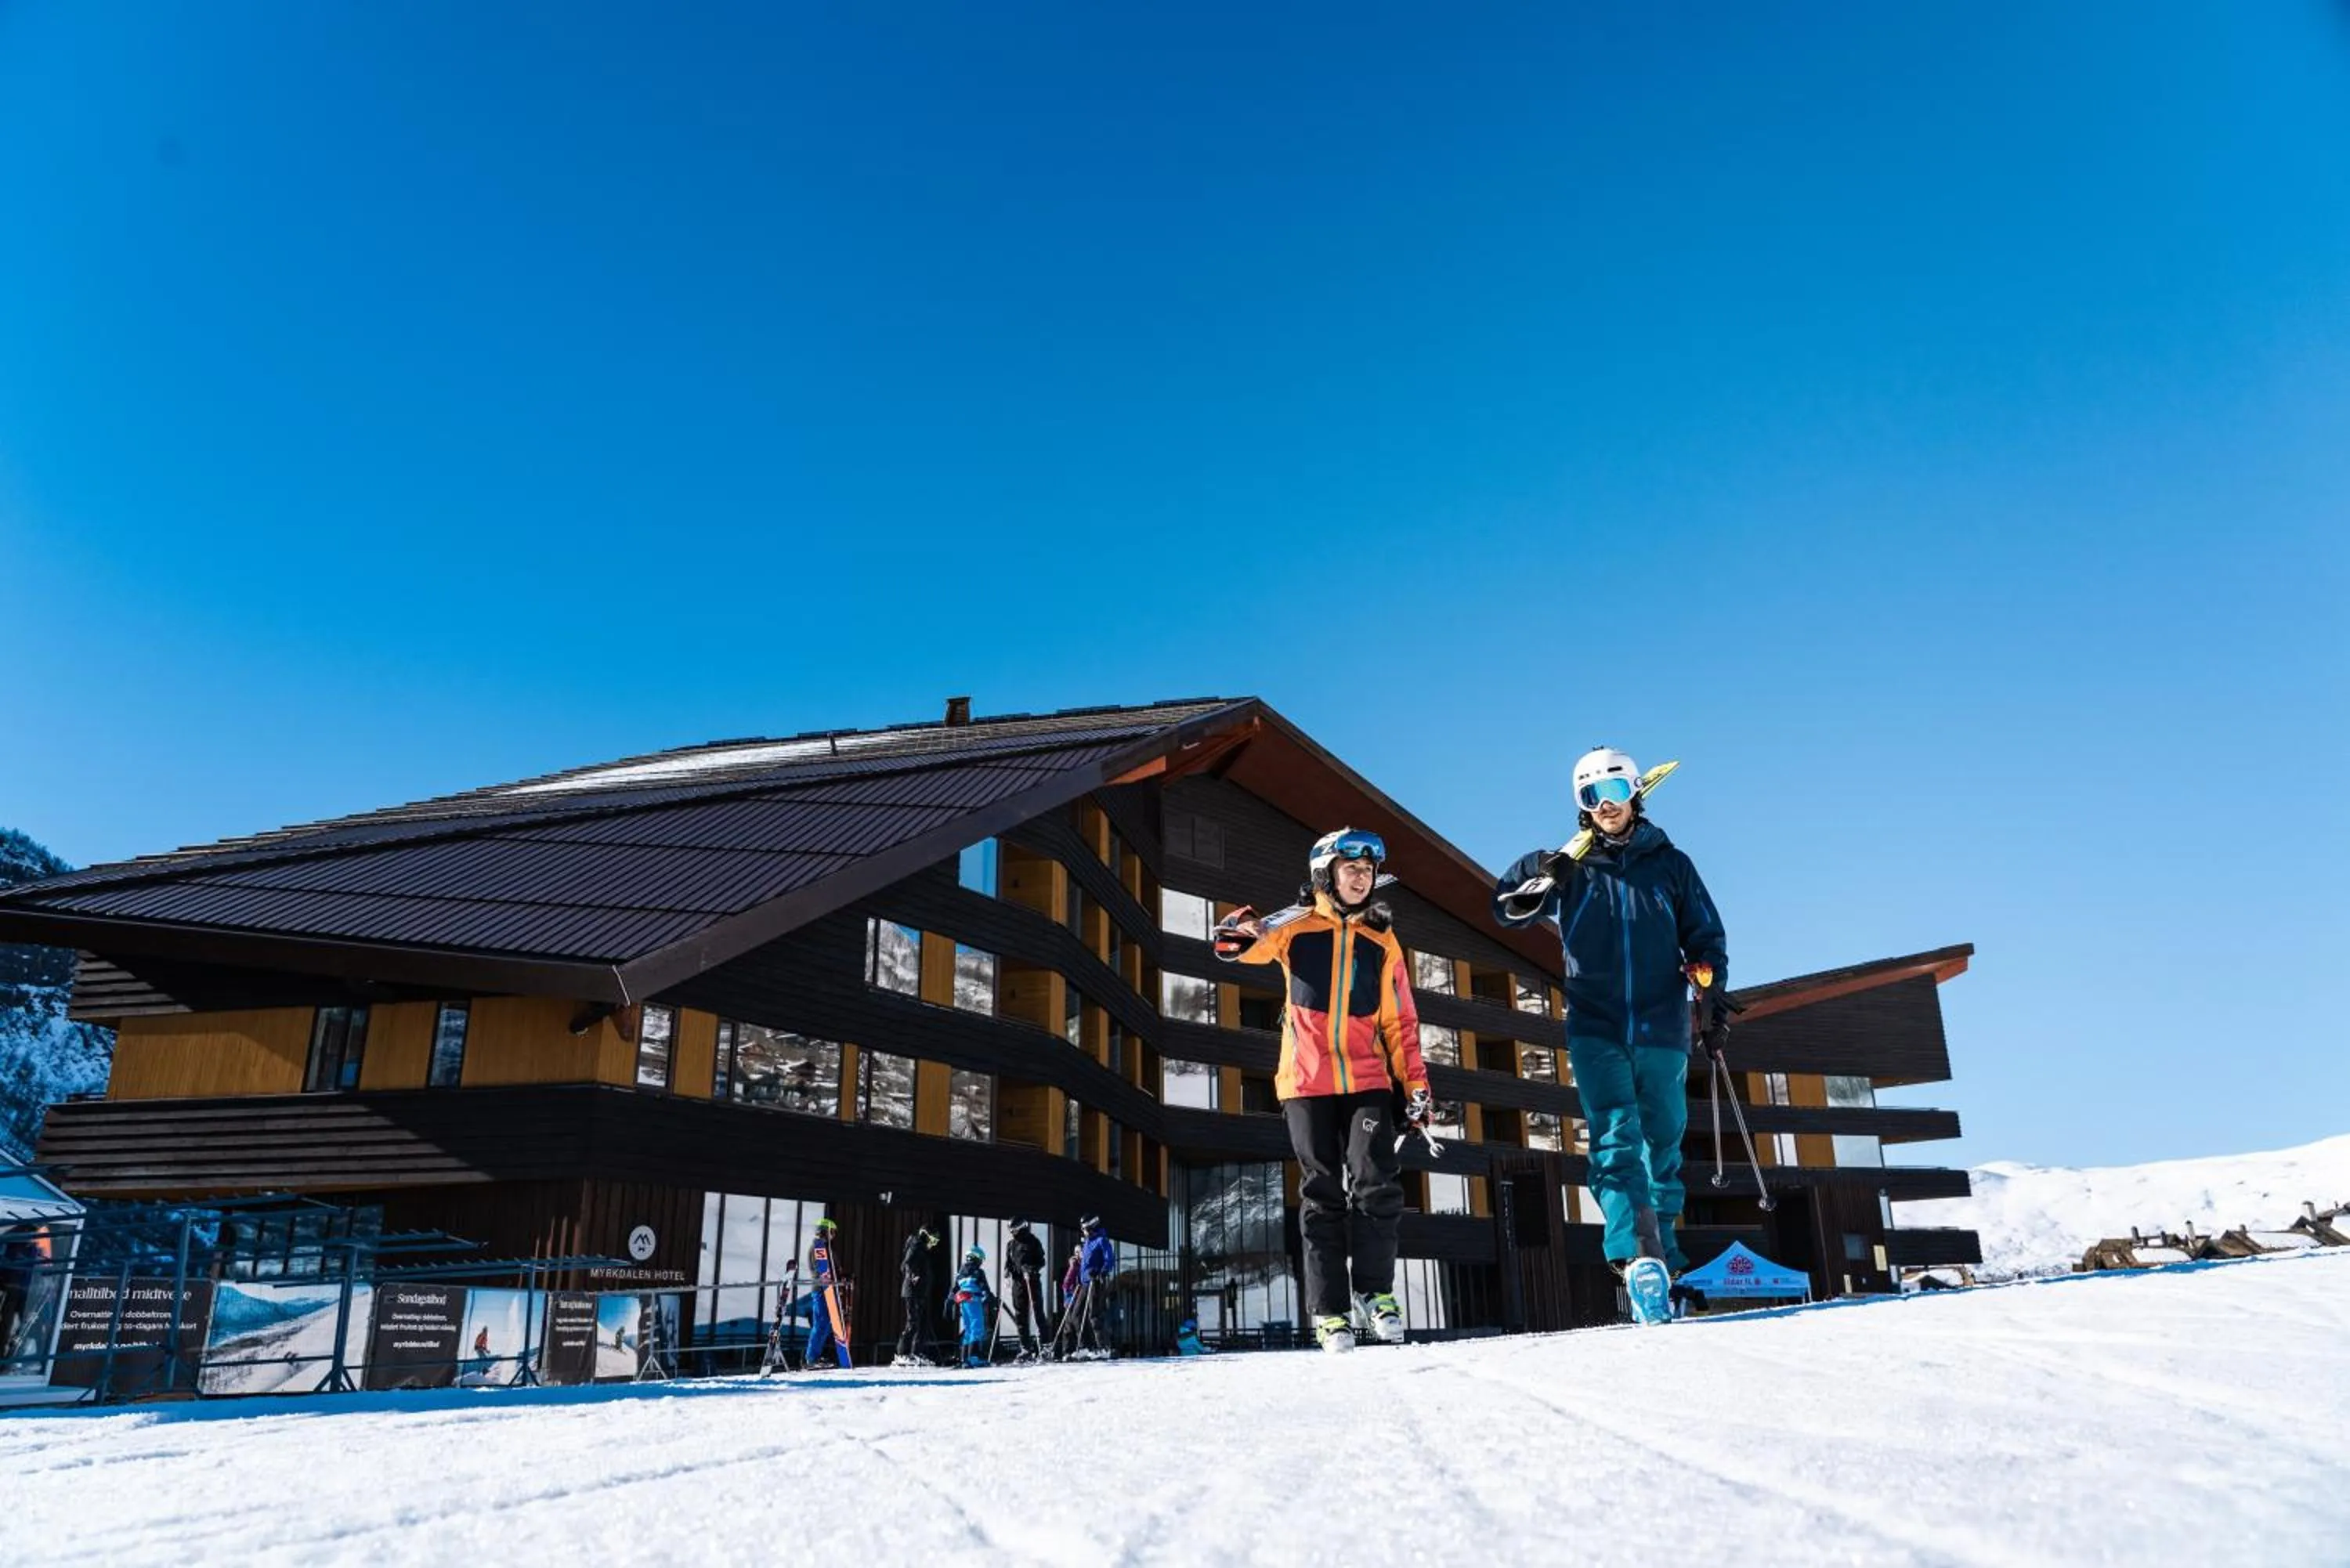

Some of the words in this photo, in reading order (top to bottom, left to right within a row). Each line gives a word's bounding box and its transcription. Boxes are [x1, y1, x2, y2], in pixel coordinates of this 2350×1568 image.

[590, 1268, 651, 1279] MYRKDALEN
[654, 1270, 685, 1281] HOTEL
[132, 1288, 192, 1301] midtvee
